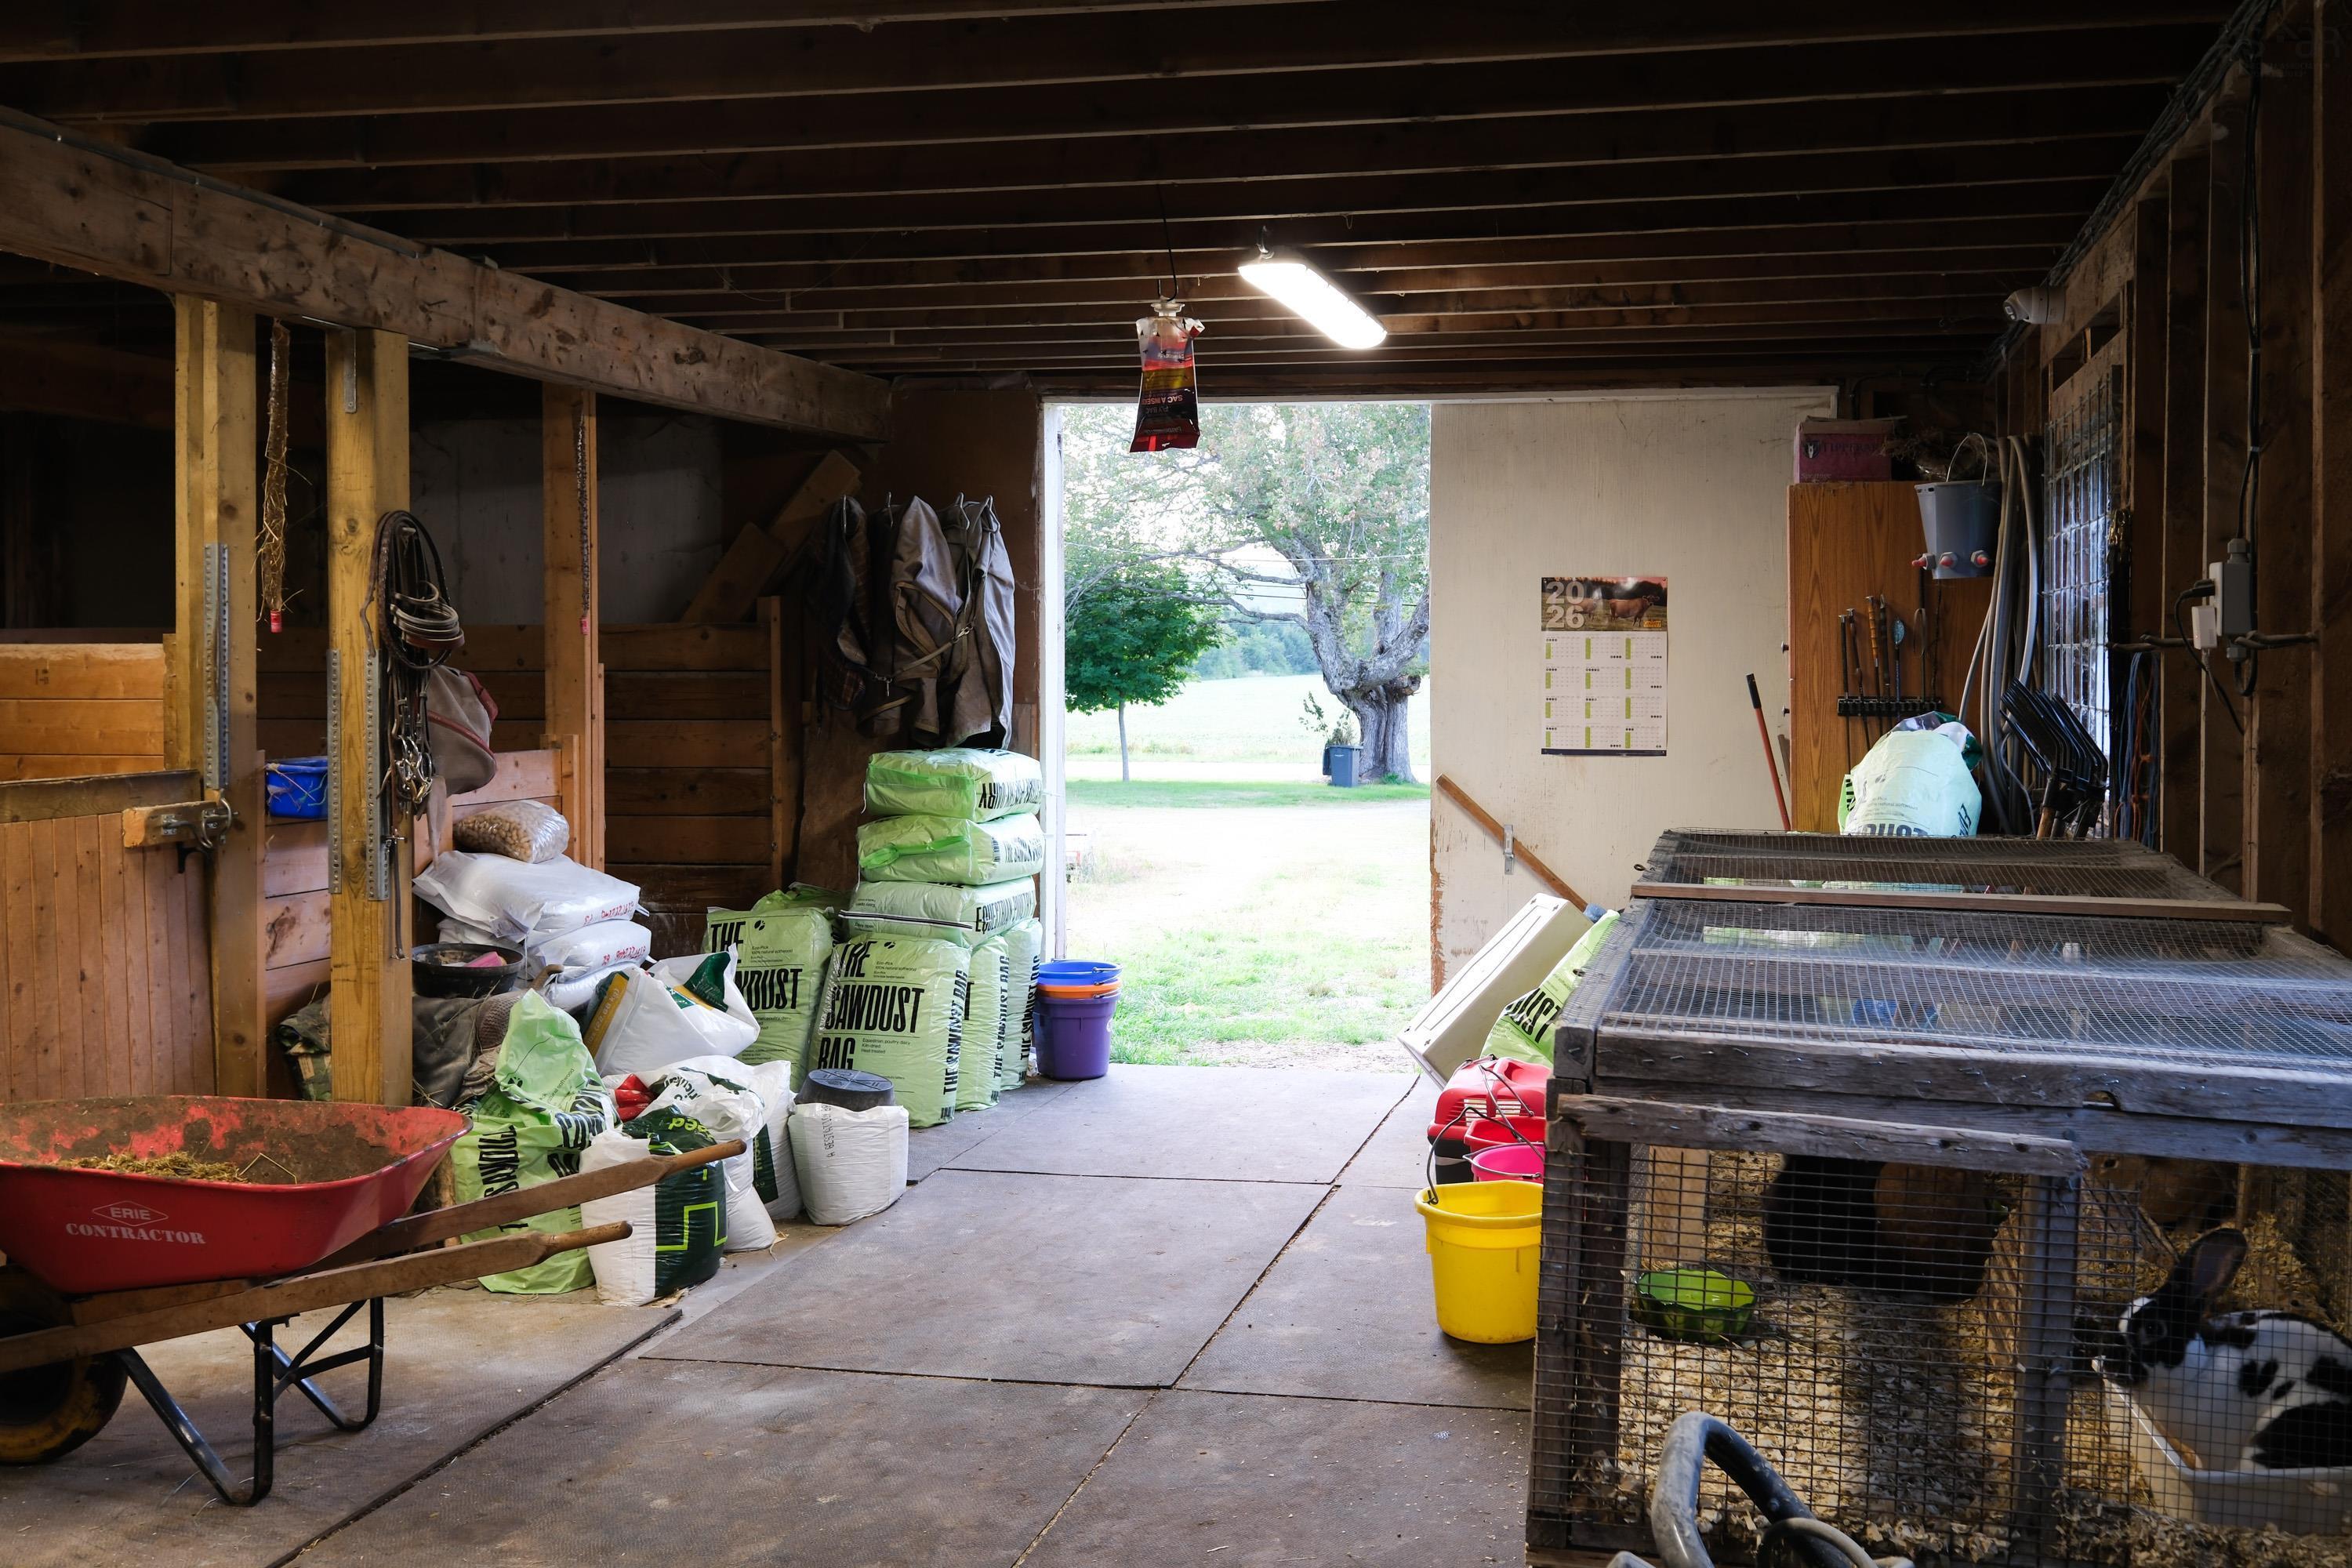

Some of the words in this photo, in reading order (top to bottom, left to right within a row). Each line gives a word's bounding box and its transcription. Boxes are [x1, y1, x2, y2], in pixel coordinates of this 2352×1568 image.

[1546, 581, 1584, 604] 20
[1546, 605, 1584, 628] 26
[825, 983, 925, 1033] SAWDUST
[818, 1036, 856, 1070] BAG
[110, 1207, 151, 1221] ERIE
[66, 1223, 206, 1244] CONTRACTOR
